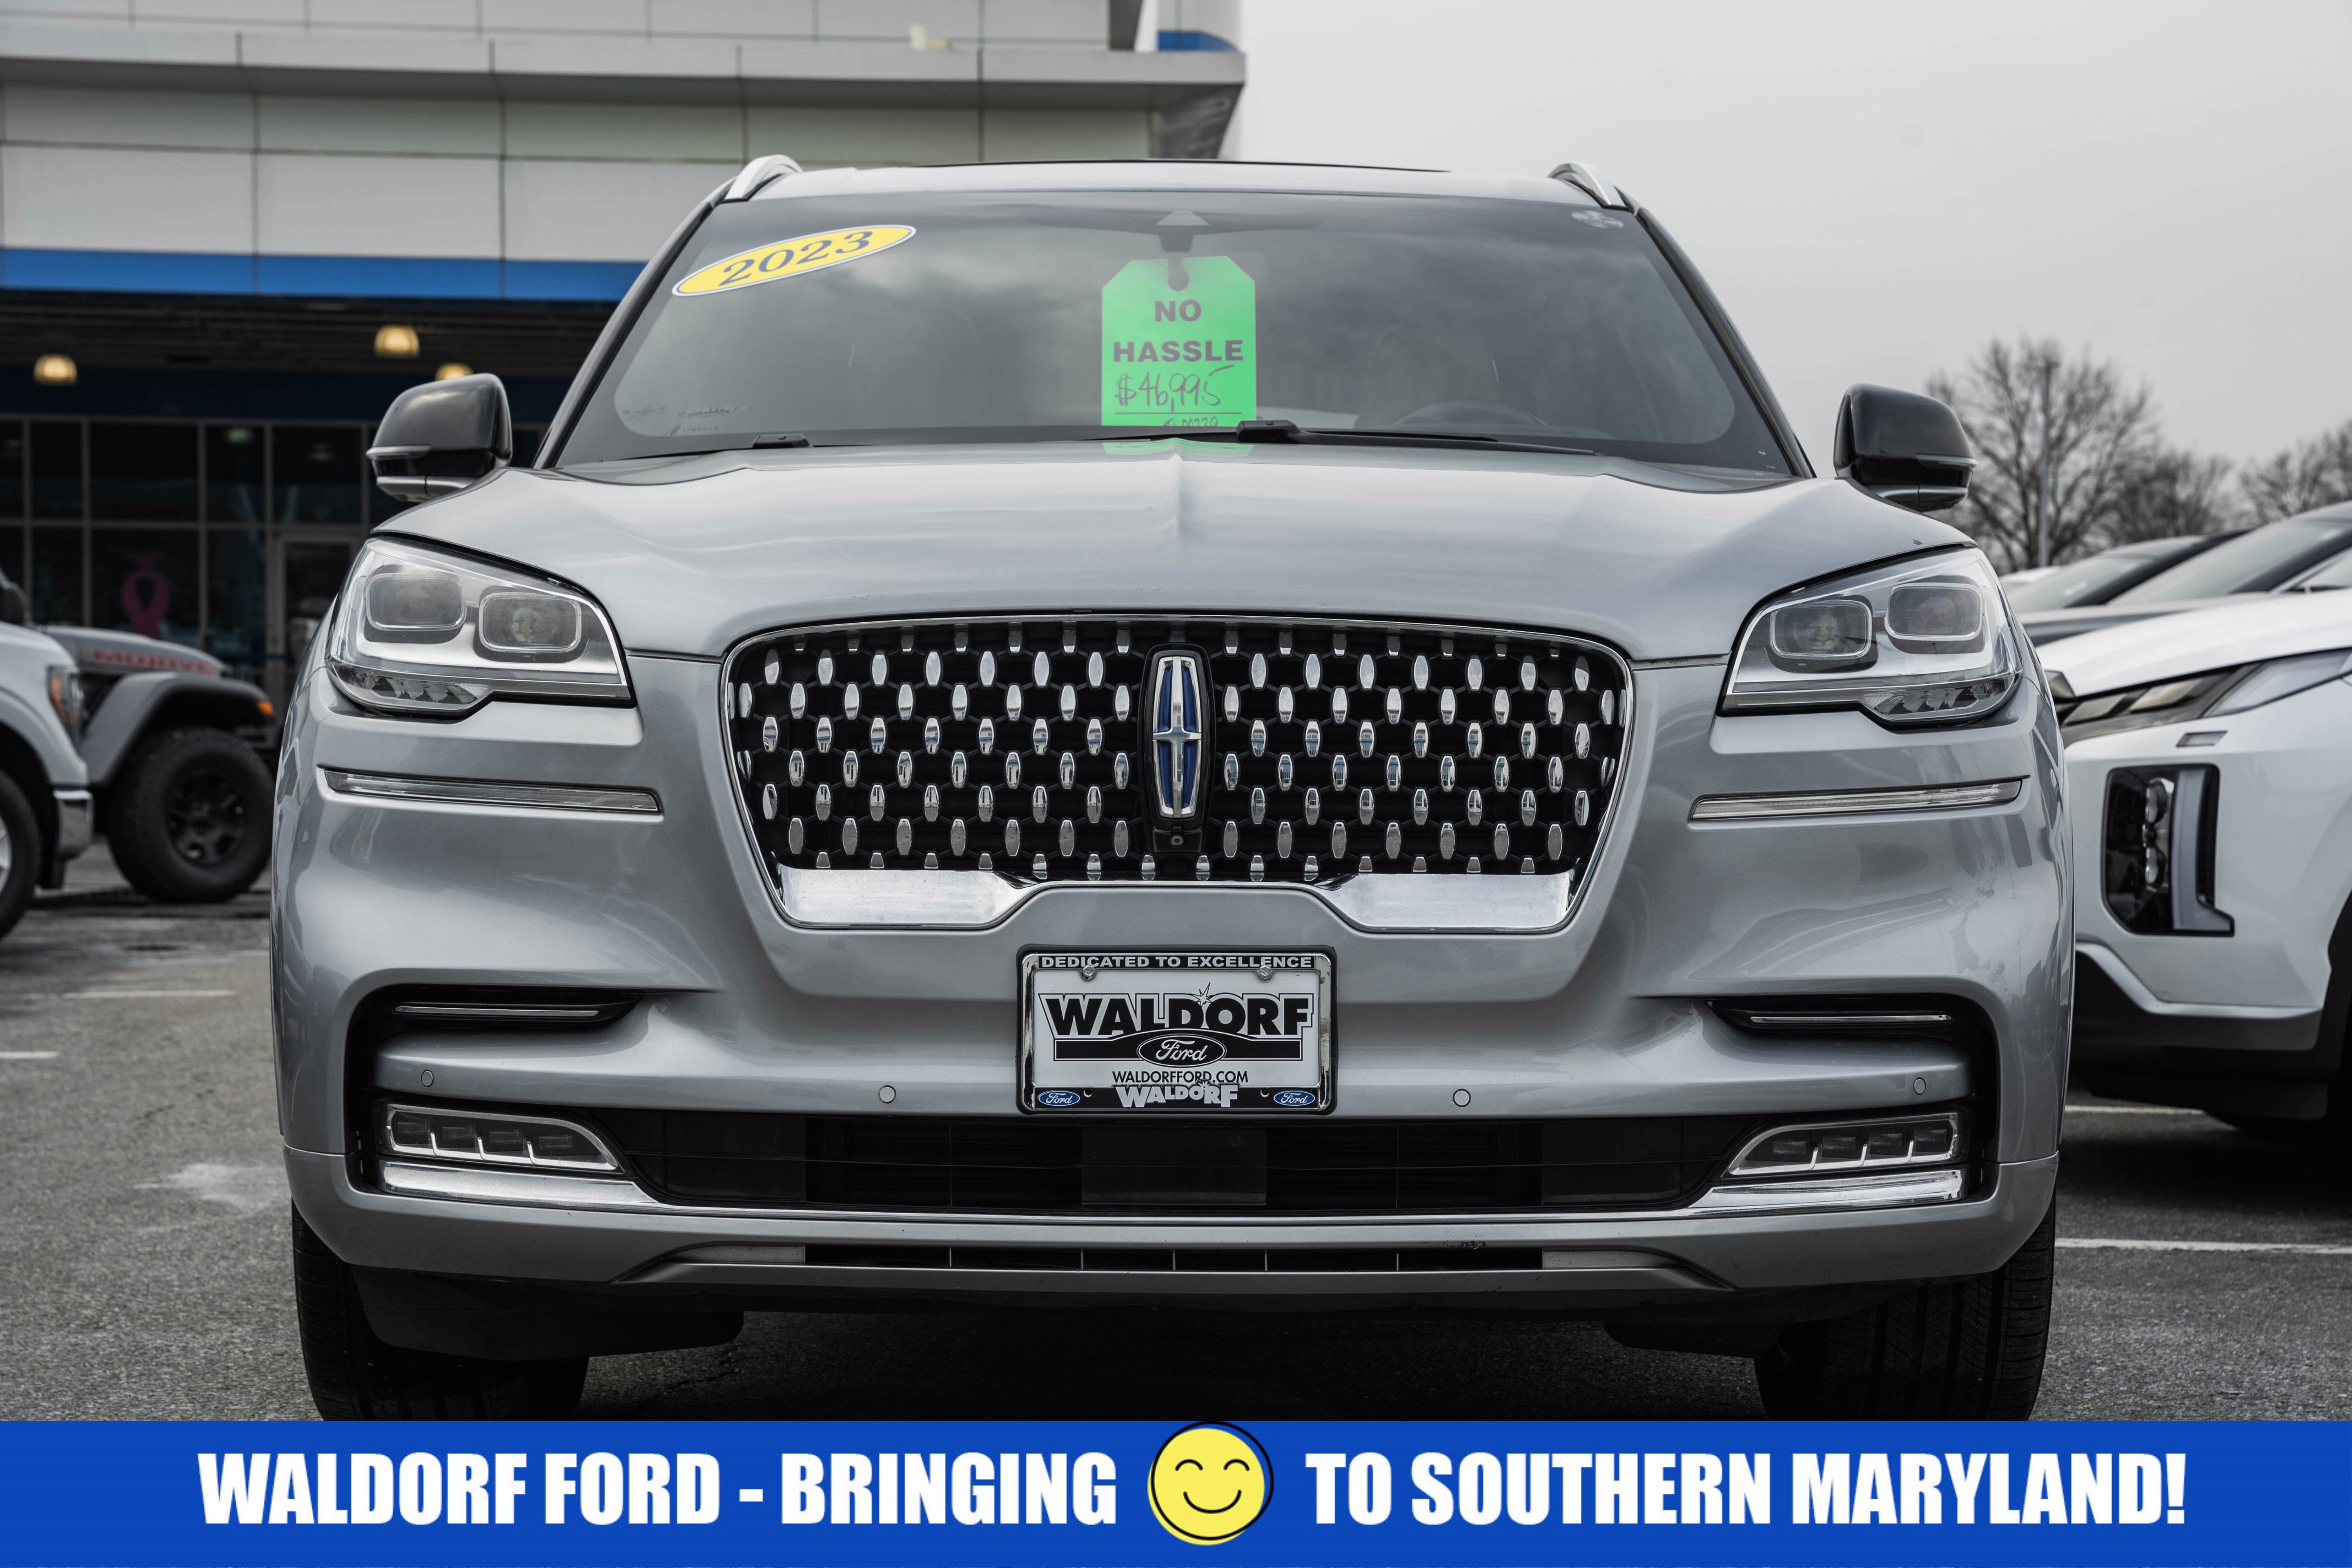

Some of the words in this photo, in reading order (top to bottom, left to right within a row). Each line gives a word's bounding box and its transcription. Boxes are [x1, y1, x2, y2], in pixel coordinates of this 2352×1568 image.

[718, 231, 874, 286] 2023
[1154, 299, 1202, 322] NO
[1113, 339, 1244, 363] HASSLE
[1114, 364, 1235, 412] $46,995
[1042, 956, 1150, 968] DEDICATED
[1155, 957, 1180, 968] TO
[1187, 956, 1312, 968] EXCELLENCE
[1039, 993, 1314, 1039] WALDORF
[1155, 1038, 1208, 1062] Ford
[1112, 1071, 1248, 1083] WALDORFFORD.COM
[1045, 1092, 1073, 1106] Ford
[1116, 1084, 1238, 1107] WALDORF
[1281, 1092, 1310, 1106] Ford
